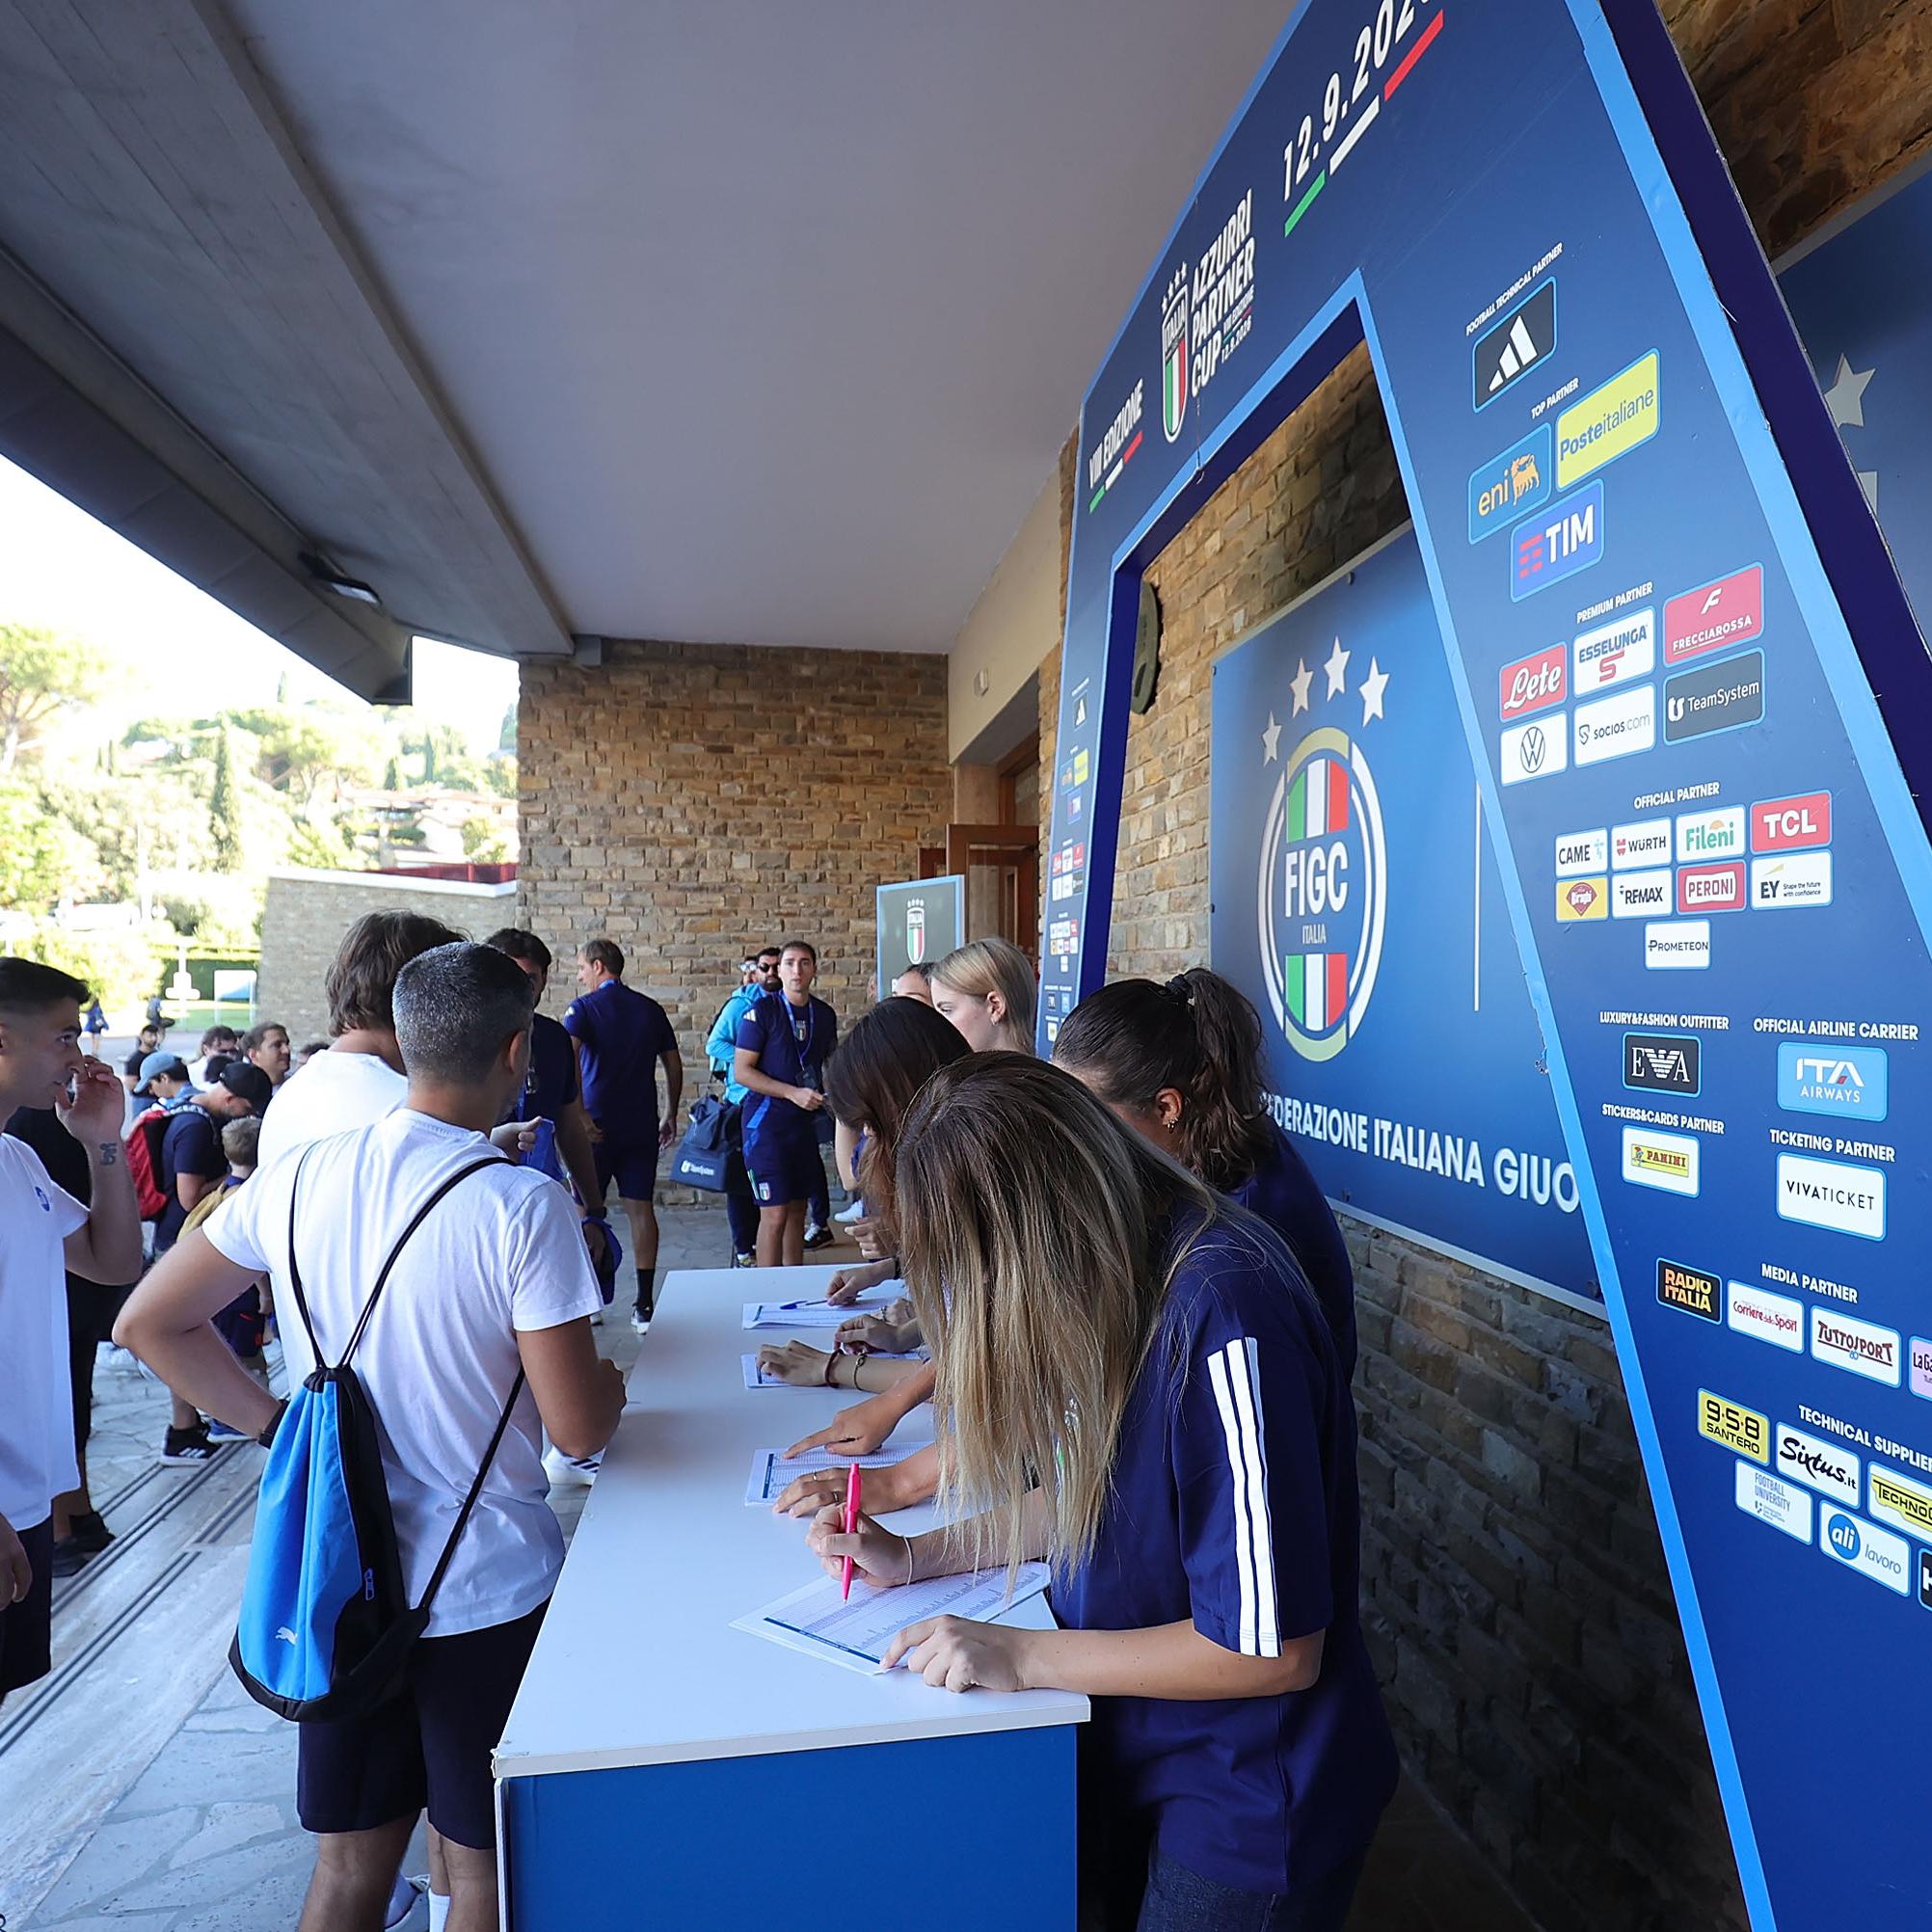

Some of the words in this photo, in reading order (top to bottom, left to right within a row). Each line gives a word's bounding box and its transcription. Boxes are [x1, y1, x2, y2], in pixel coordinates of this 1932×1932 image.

[1284, 0, 1429, 201] 12.9.202
[1192, 188, 1251, 312] AZZURRI
[1192, 237, 1255, 356] PARTNER
[1466, 303, 1495, 336] FOOTBALL
[1495, 271, 1532, 309] TECHNICAL
[1532, 242, 1563, 278] PARTNER
[1192, 330, 1221, 398] CUP
[1531, 400, 1545, 419] TOP
[1546, 377, 1579, 409] PARTNER
[1103, 377, 1143, 470] EDIZIONE
[1560, 389, 1654, 461] Posteitaliane
[1478, 468, 1510, 517] eni
[1545, 504, 1594, 564] TIM
[1577, 598, 1614, 625] PREMIUM
[1615, 581, 1653, 607] PARTNER
[1579, 625, 1647, 663] ESSELUNGA
[1673, 615, 1753, 652] FRECCIAROSSA
[1503, 661, 1562, 711] Lete
[1687, 681, 1760, 712] TeamSystem
[1634, 790, 1675, 810] OFFICIAL
[1677, 781, 1720, 801] PARTNER
[1685, 820, 1734, 851] Fileni
[1762, 809, 1817, 839] TCL
[1558, 844, 1591, 865] CAME
[1628, 835, 1667, 853] WÜRTH
[1285, 841, 1348, 918] FIGC
[1687, 877, 1733, 899] PERONI
[1760, 879, 1781, 899] EY
[1301, 924, 1327, 944] ITALIA
[1599, 1011, 1678, 1028] LUXURY&FASHION
[1679, 1014, 1730, 1031] OUTFITTER
[1754, 1018, 1805, 1034] OFFICIAL
[1809, 1021, 1856, 1037] AIRLINE
[1859, 1023, 1919, 1041] CARRIER
[1796, 1058, 1865, 1087] ITA
[1801, 1086, 1862, 1104] AIRWAYS
[1602, 1103, 1679, 1127] STICKERS&CARDS
[1680, 1115, 1725, 1135] PARTNER
[1259, 1091, 1368, 1153] DERAZIONE
[1374, 1118, 1486, 1187] ITALIANA
[1494, 1147, 1581, 1214] GIUO
[1647, 1150, 1687, 1167] PANINI
[1769, 1129, 1833, 1152] TICKETING
[1836, 1139, 1895, 1163] PARTNER
[1786, 1179, 1875, 1211] VIVATICKET
[1665, 1268, 1712, 1296] RADIO
[1761, 1263, 1799, 1287] MEDIA
[1801, 1274, 1859, 1303] PARTNER
[1665, 1285, 1712, 1313] ITALIA
[1733, 1301, 1763, 1321] Corriere
[1775, 1314, 1798, 1332] Sport
[1817, 1320, 1893, 1362] TUTTOSPORT
[1706, 1422, 1760, 1455] SANTERO
[1799, 1404, 1872, 1448] TECHNICAL
[1779, 1436, 1858, 1490] Sixtus.it
[1831, 1525, 1856, 1551] ali
[1865, 1543, 1902, 1574] lavoro
